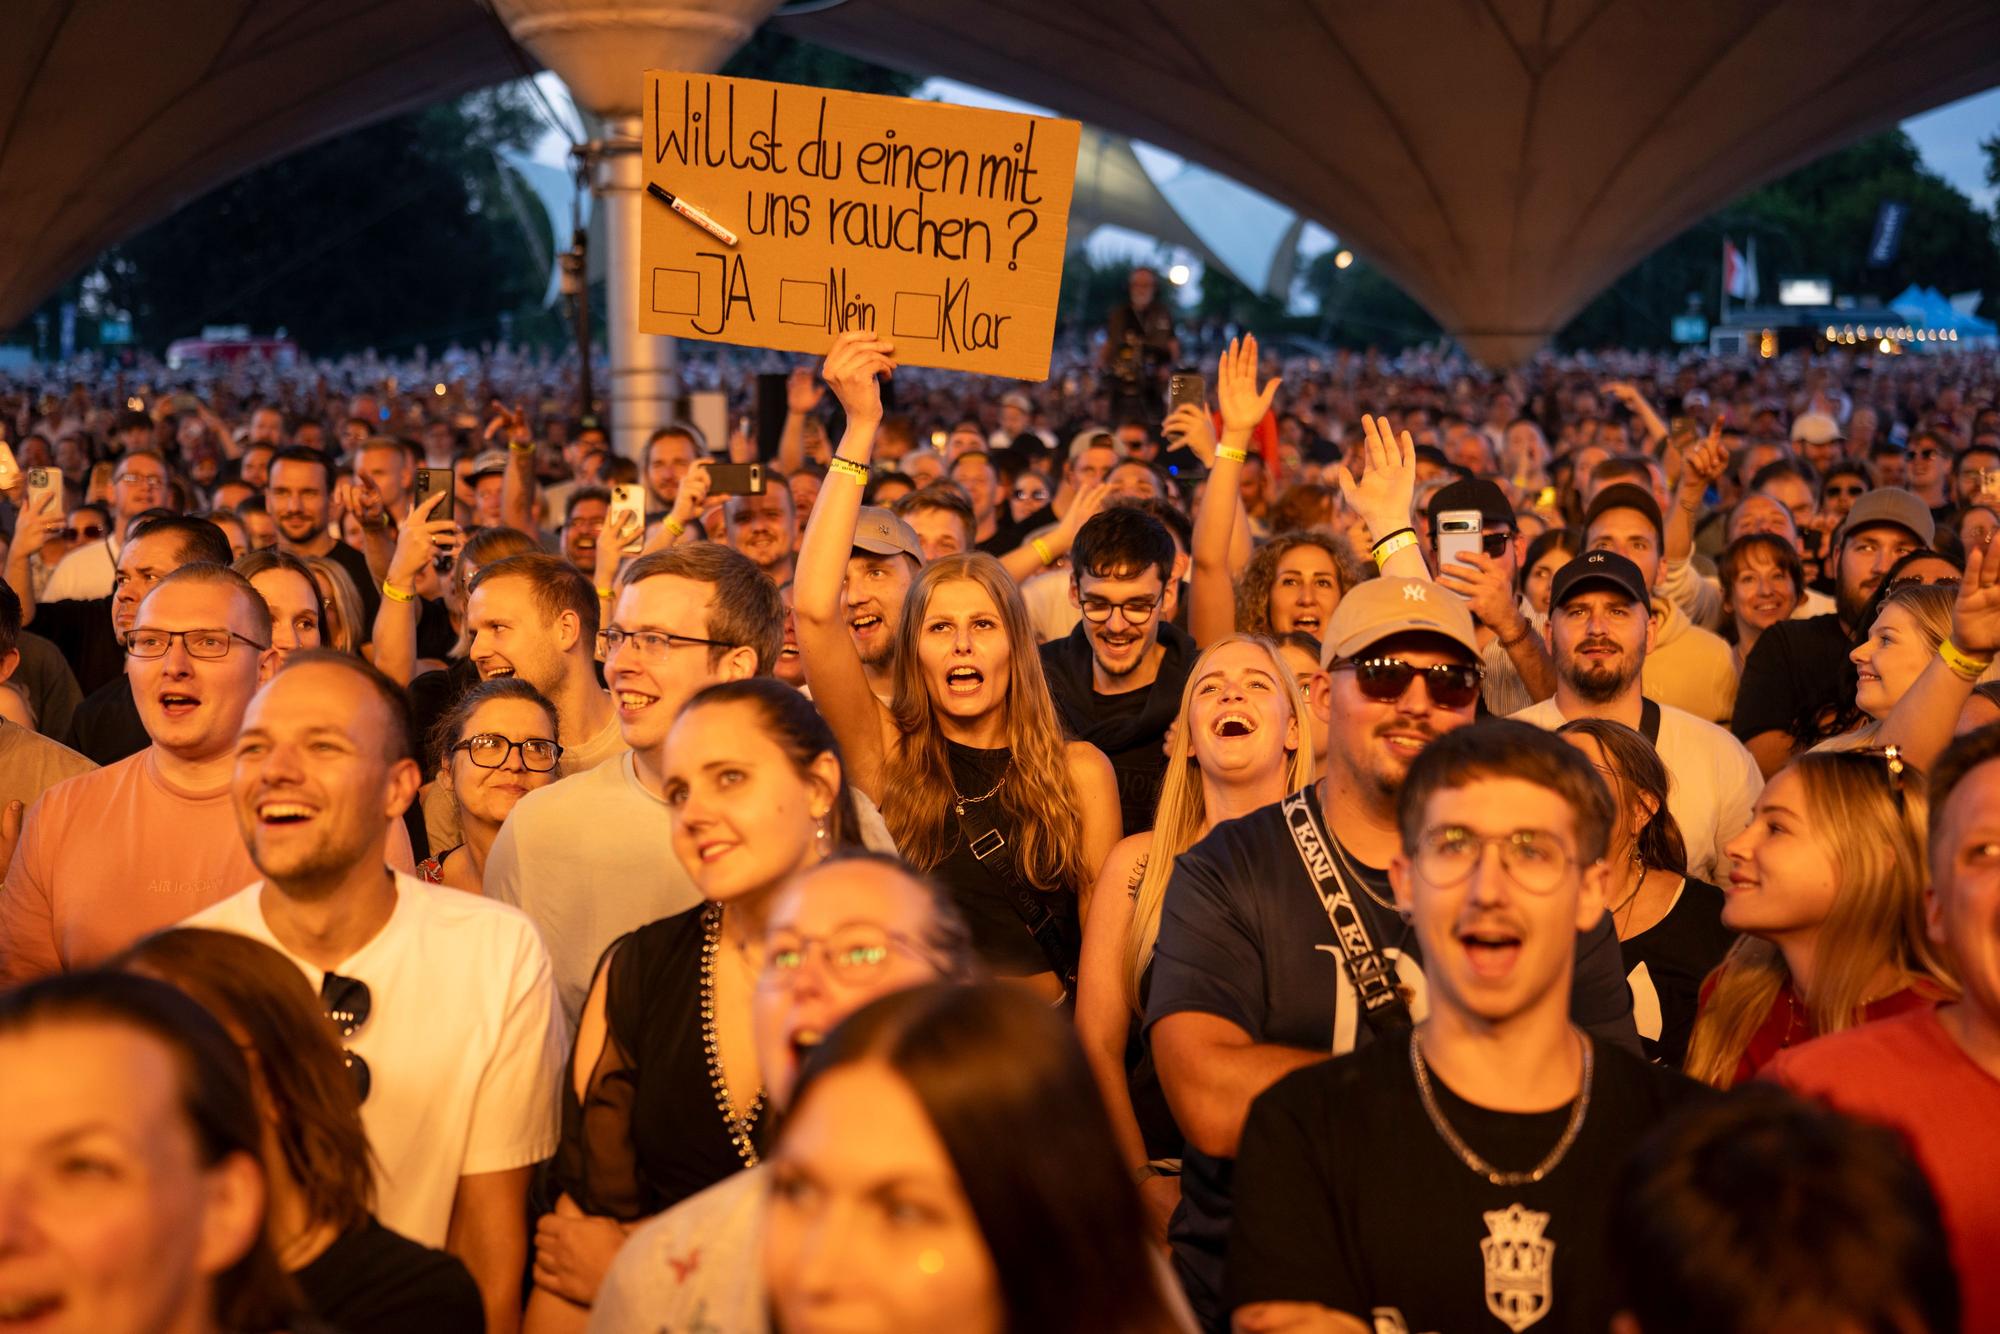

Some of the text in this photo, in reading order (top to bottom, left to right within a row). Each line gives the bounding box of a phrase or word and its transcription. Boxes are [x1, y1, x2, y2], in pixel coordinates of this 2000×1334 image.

[655, 78, 1043, 205] Willst du einen mit
[746, 190, 810, 238] uns
[829, 192, 991, 263] rauchen
[691, 252, 1012, 354] JA Nein Klar
[1300, 821, 1334, 882] KANI
